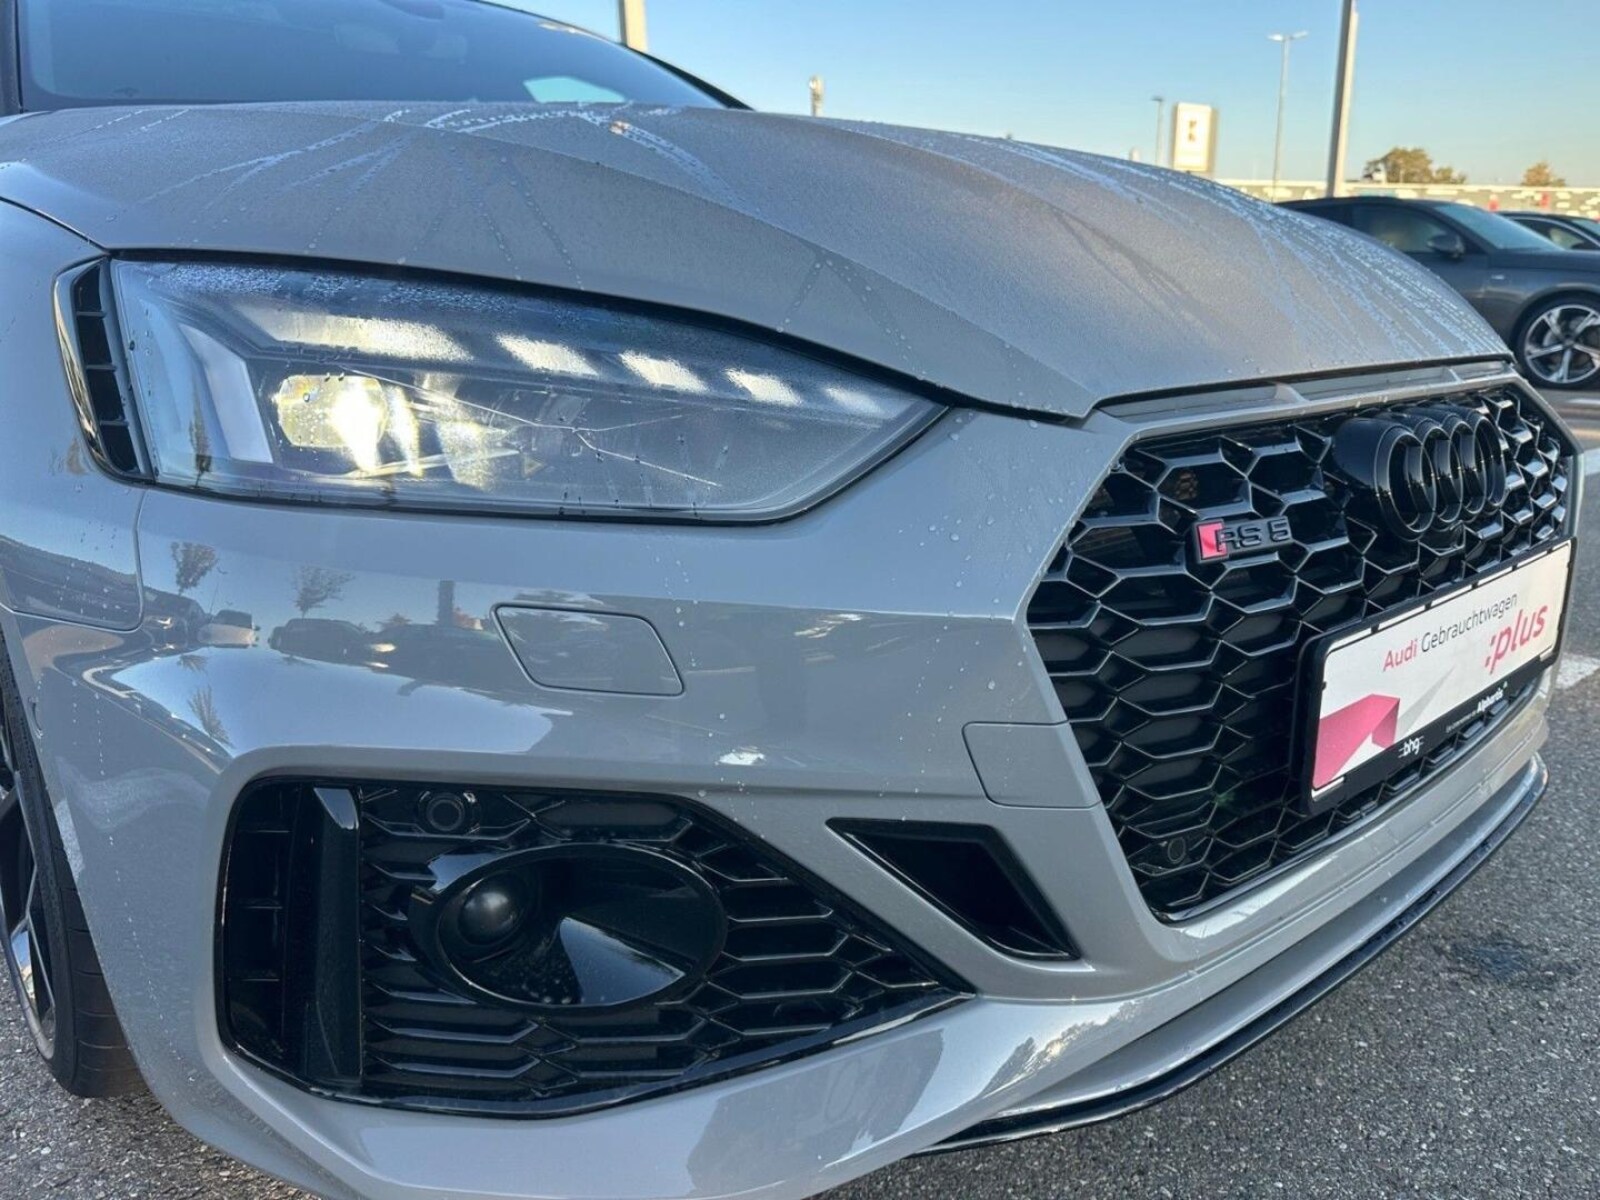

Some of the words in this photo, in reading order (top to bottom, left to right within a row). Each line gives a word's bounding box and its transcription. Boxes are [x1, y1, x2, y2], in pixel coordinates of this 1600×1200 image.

[1215, 525, 1262, 553] RS
[1383, 639, 1418, 672] Audi
[1421, 593, 1518, 653] Gebrauchtwagen
